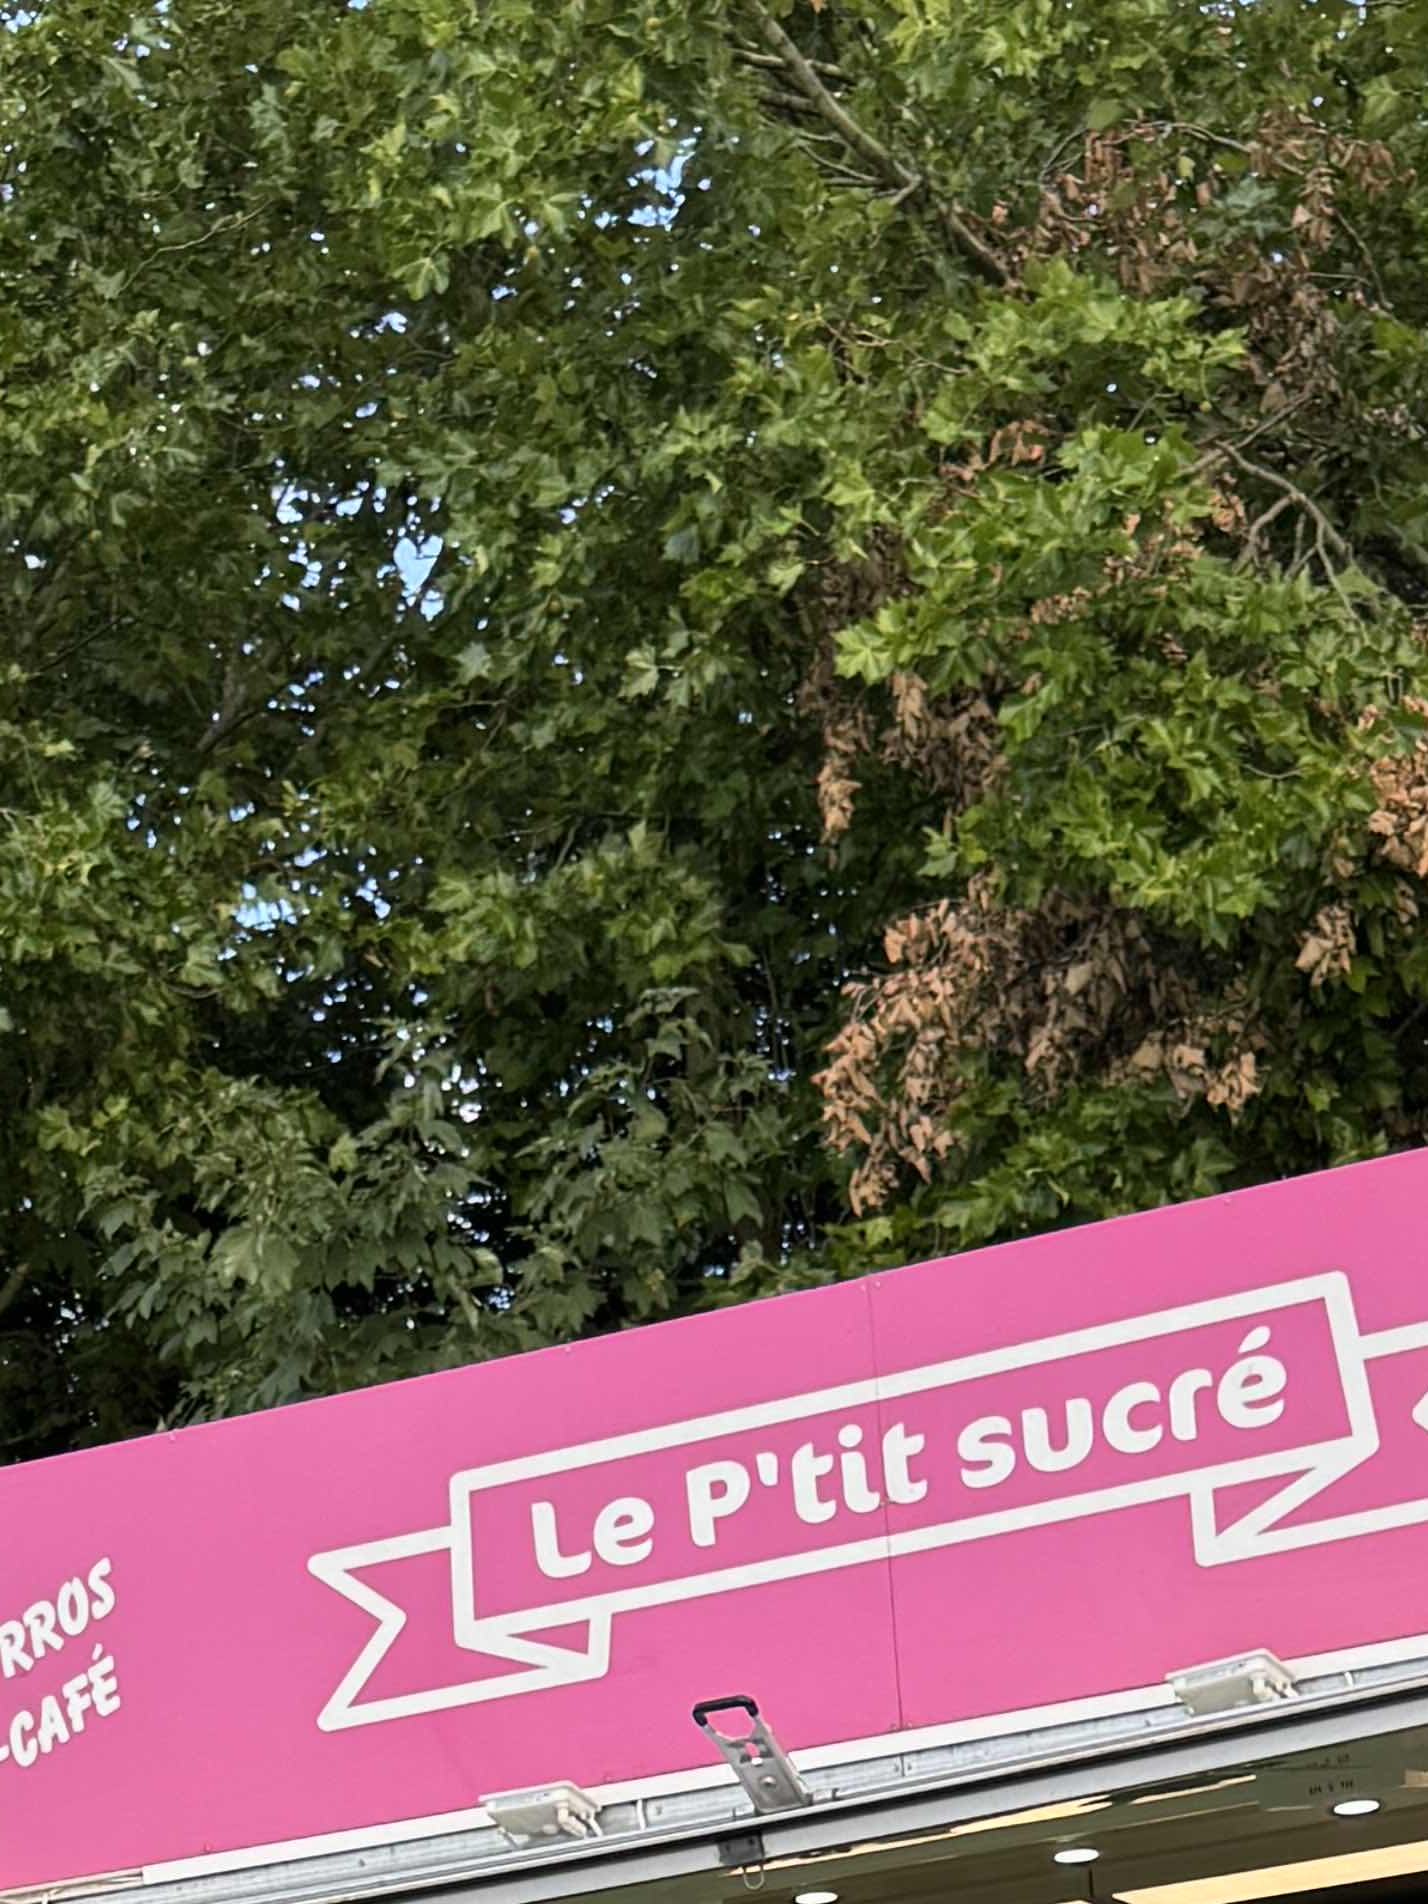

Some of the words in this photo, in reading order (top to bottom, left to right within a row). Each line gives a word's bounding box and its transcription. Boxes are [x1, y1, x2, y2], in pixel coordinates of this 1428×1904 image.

[531, 1494, 655, 1580] Le
[685, 1423, 927, 1548] P'tit
[957, 1324, 1290, 1491] sucré
